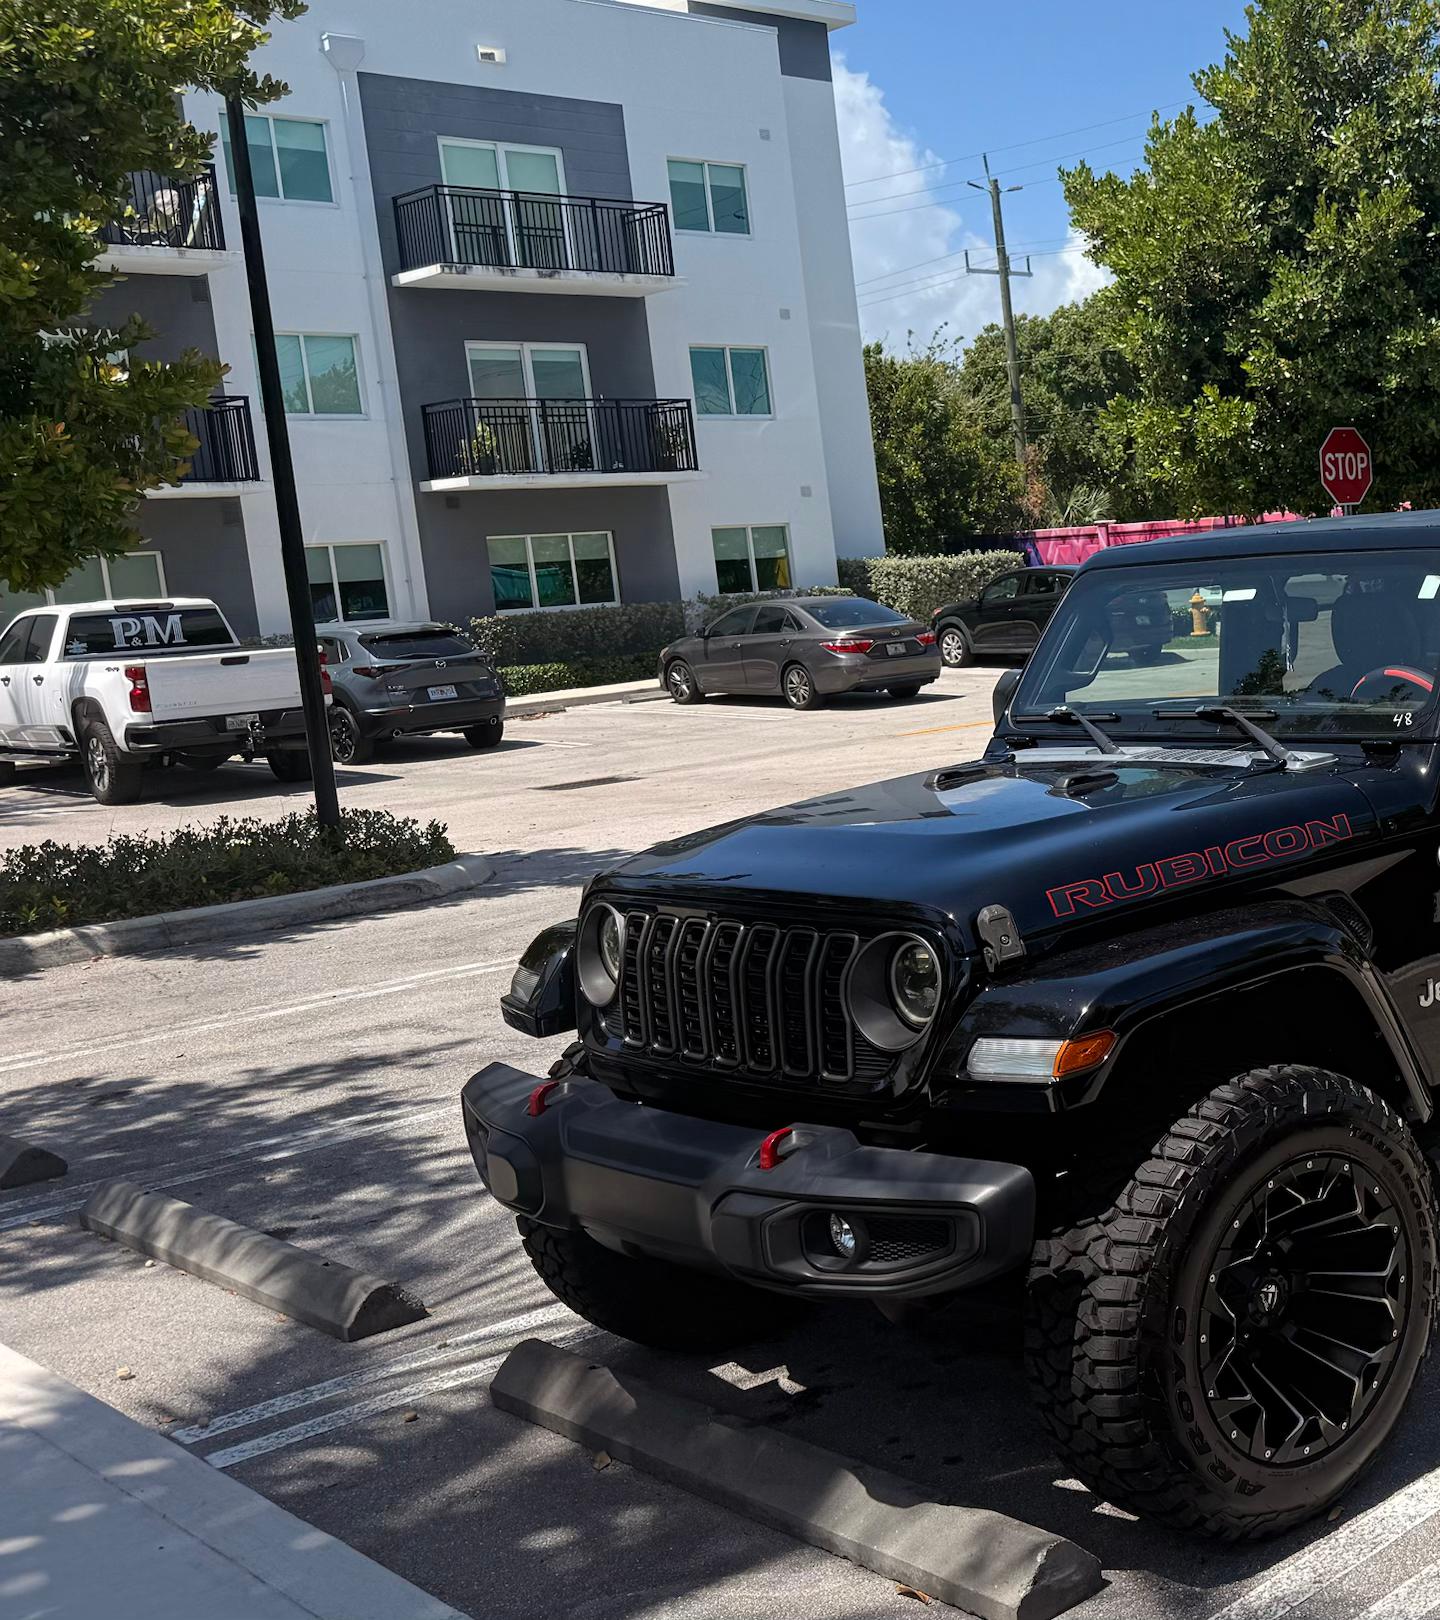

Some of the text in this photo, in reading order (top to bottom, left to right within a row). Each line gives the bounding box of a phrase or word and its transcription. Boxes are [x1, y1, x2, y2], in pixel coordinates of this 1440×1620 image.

[1324, 452, 1368, 481] STOP
[1392, 712, 1413, 728] 48
[1046, 814, 1353, 917] RUBICON
